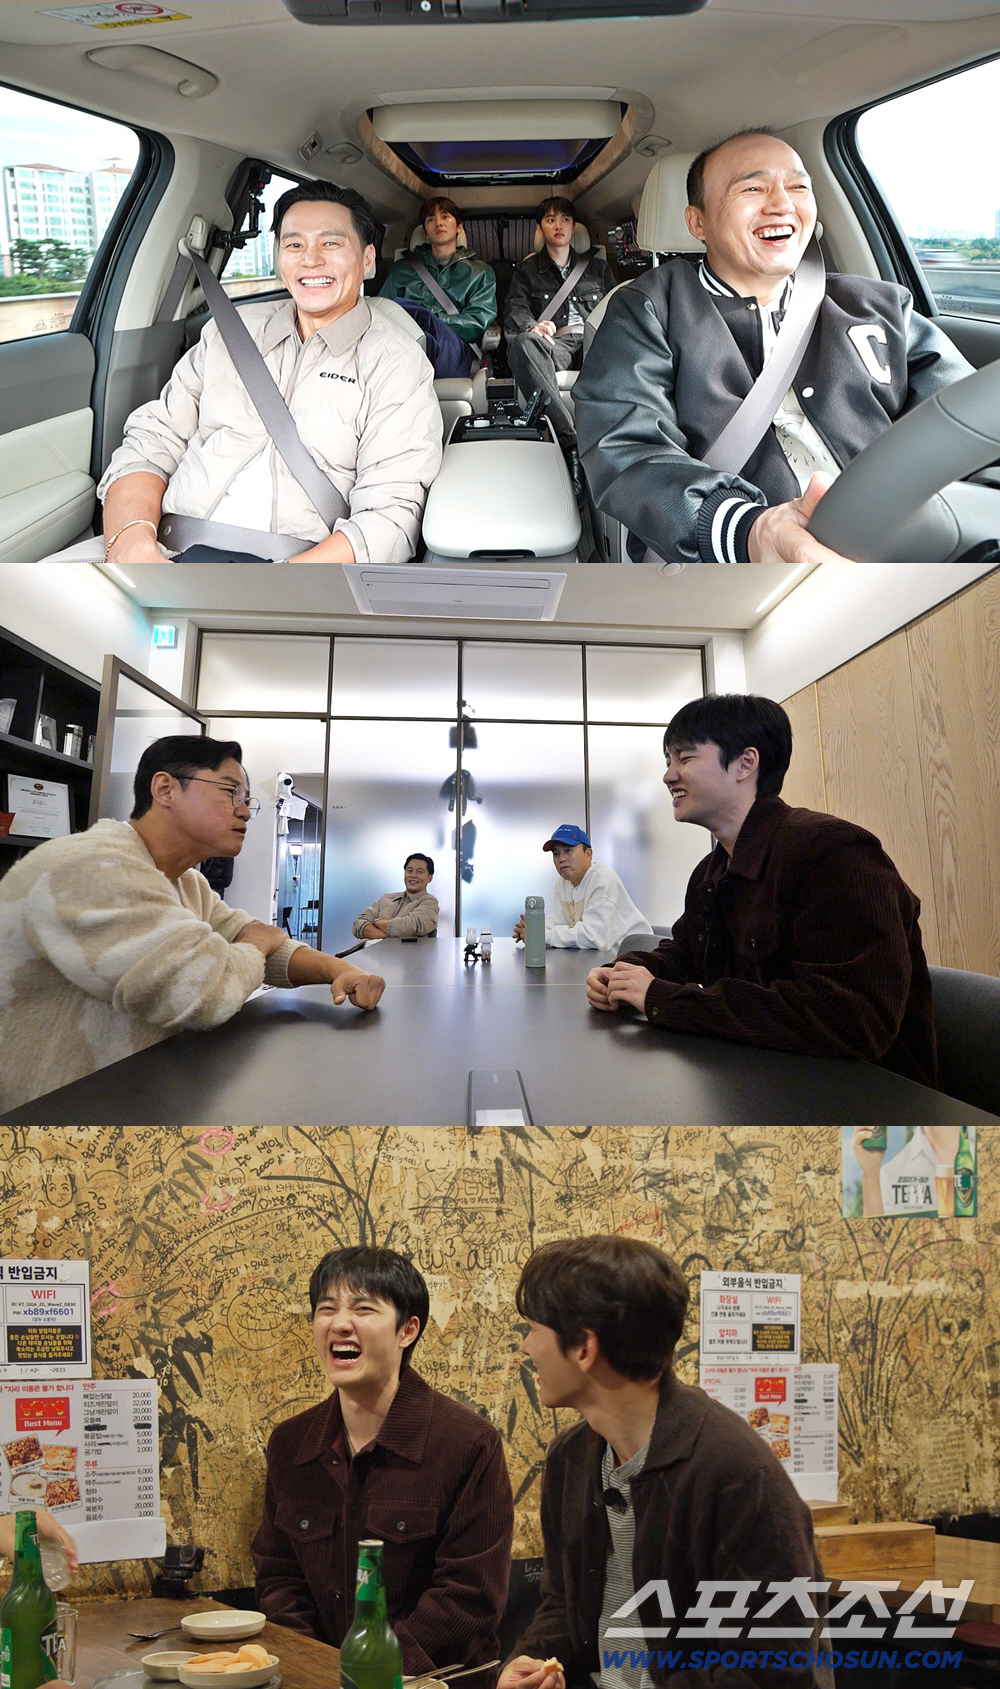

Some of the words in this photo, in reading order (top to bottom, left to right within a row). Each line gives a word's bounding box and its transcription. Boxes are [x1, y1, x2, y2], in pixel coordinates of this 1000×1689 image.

[846, 324, 892, 385] C
[319, 372, 356, 384] EIDER
[8, 1266, 57, 1280] 반입금지
[722, 1277, 752, 1288] 외부음식
[754, 1278, 782, 1289] 반입금지
[31, 1290, 56, 1299] WIFI
[720, 1295, 737, 1304] 화장실
[719, 1329, 737, 1337] 앞치마
